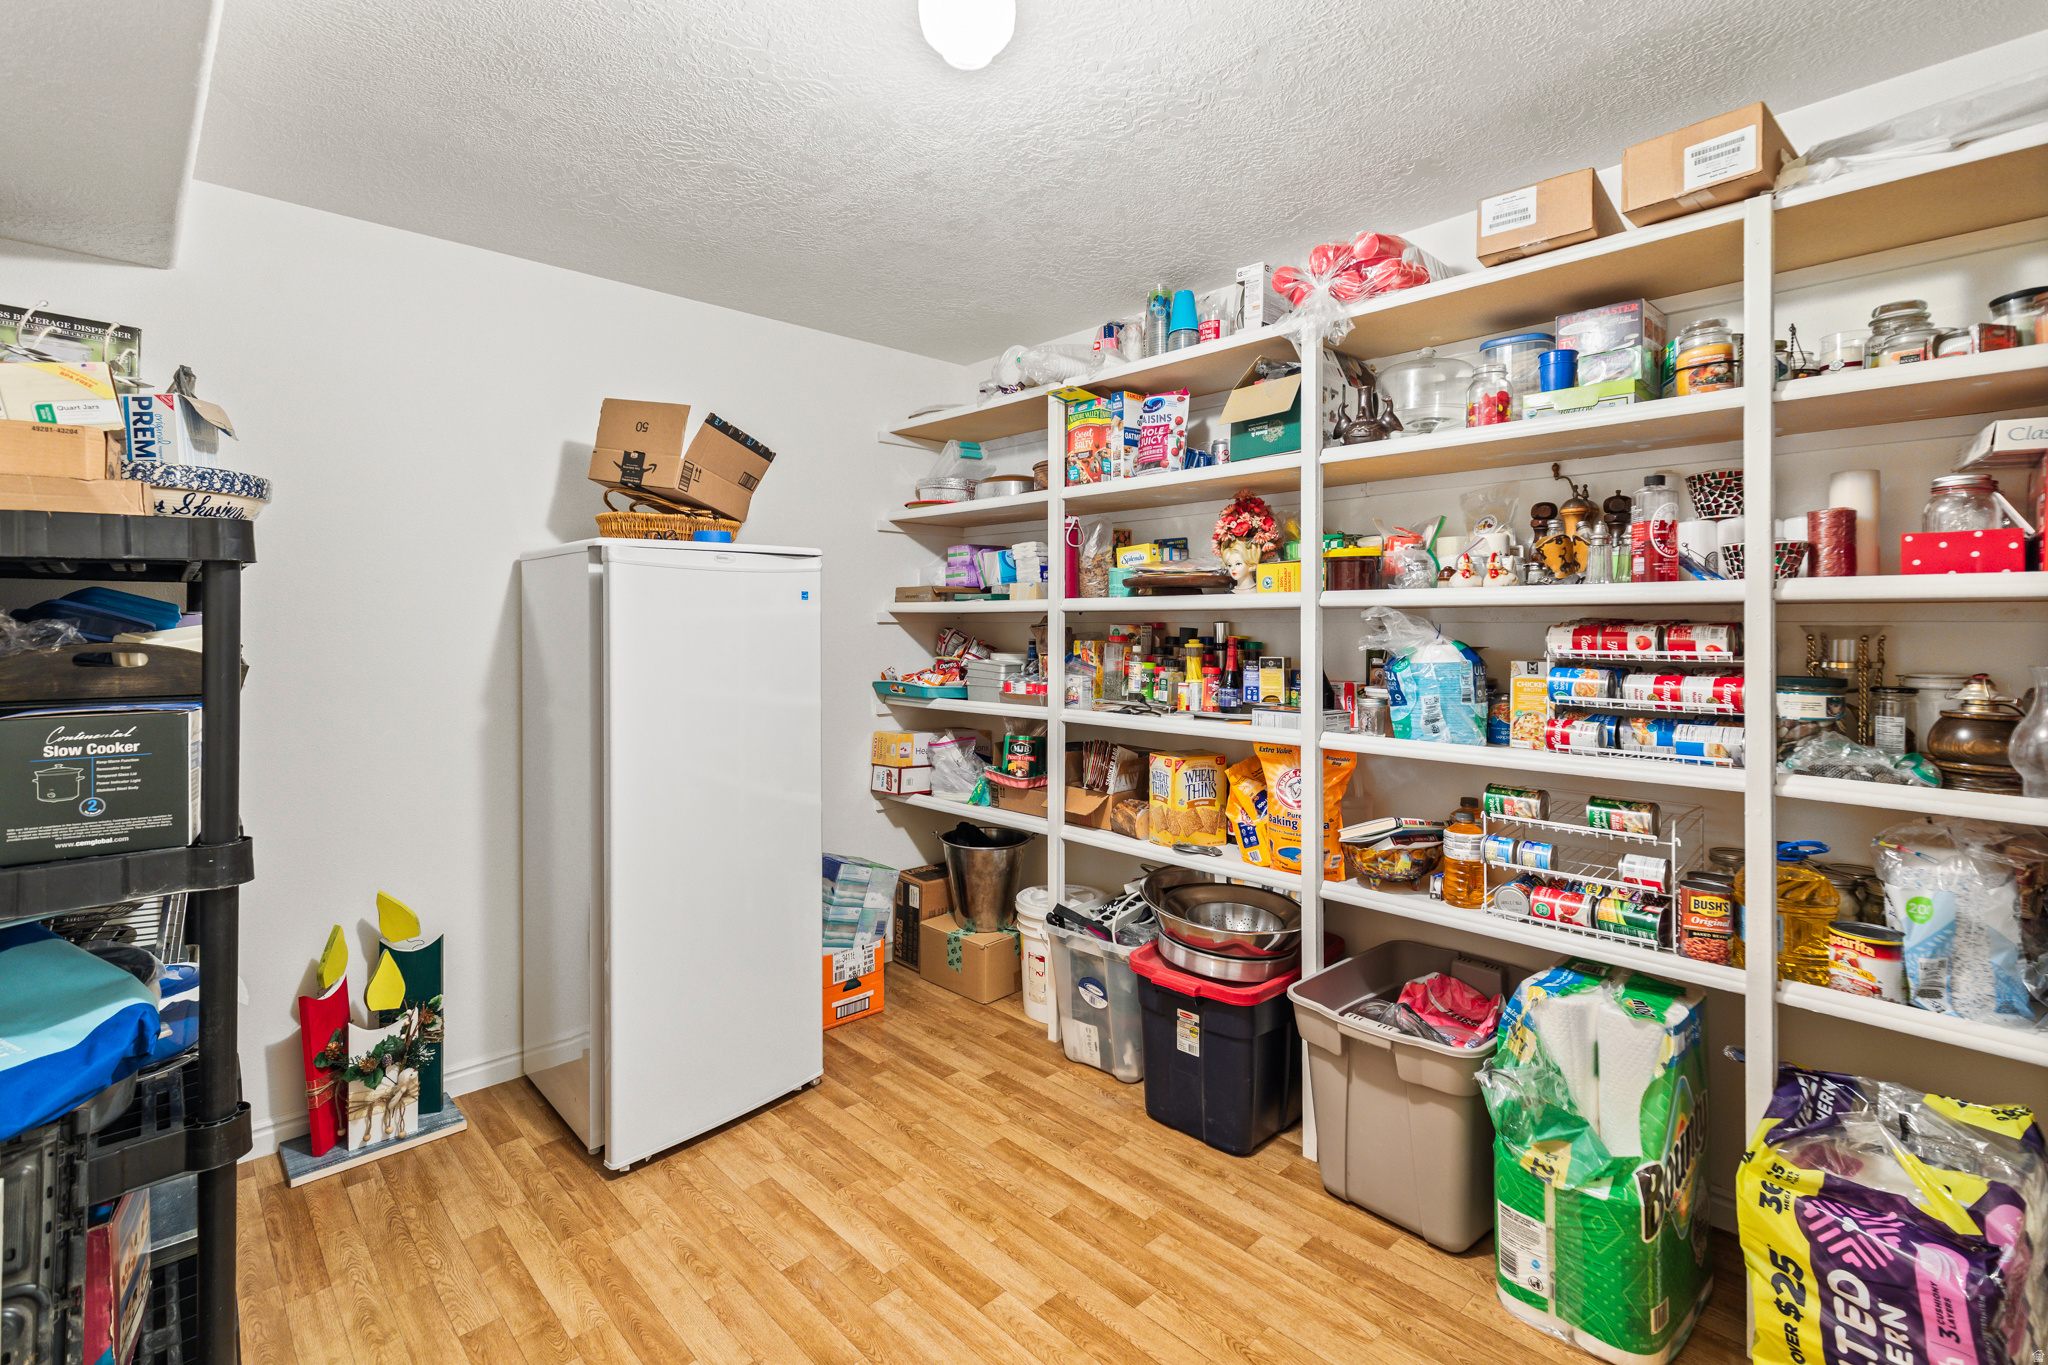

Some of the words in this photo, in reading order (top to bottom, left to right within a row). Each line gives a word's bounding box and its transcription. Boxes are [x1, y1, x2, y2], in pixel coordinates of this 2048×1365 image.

[1560, 314, 1591, 327] SALSA
[1595, 303, 1639, 317] MASTER
[74, 324, 132, 340] DISPESER
[1561, 340, 1576, 348] TV
[60, 371, 73, 381] BPA
[75, 377, 94, 389] FREE
[1085, 410, 1099, 419] VALLEY
[155, 413, 171, 445] original
[635, 421, 649, 433] 50
[1074, 428, 1094, 439] Sweet
[1141, 427, 1165, 437] HOLE
[1074, 440, 1093, 450] SALTY
[1141, 435, 1163, 446] JUICY
[1121, 553, 1145, 565] Splenda
[1516, 680, 1547, 688] CHICKEN
[46, 726, 137, 745] Continental
[43, 745, 82, 758] Slow
[86, 742, 140, 755] Cooker
[1013, 745, 1030, 753] MJB
[1259, 746, 1275, 754] Extra
[1276, 746, 1292, 755] Value
[1151, 771, 1169, 785] WHEAT
[1184, 769, 1217, 784] WHEAT
[88, 800, 98, 811] 2
[1268, 813, 1298, 831] Baking
[55, 835, 129, 849] www.cemglobal.com
[1694, 898, 1729, 913] BUSH'S
[1691, 916, 1730, 927] Original
[1634, 1089, 1708, 1241] Bounty
[1771, 1250, 1806, 1323] $25
[1930, 1280, 1945, 1326] CUSHIONY
[1944, 1297, 1957, 1331] LAYERS
[1939, 1325, 1960, 1344] 3
[1784, 1323, 1806, 1364] OVER
